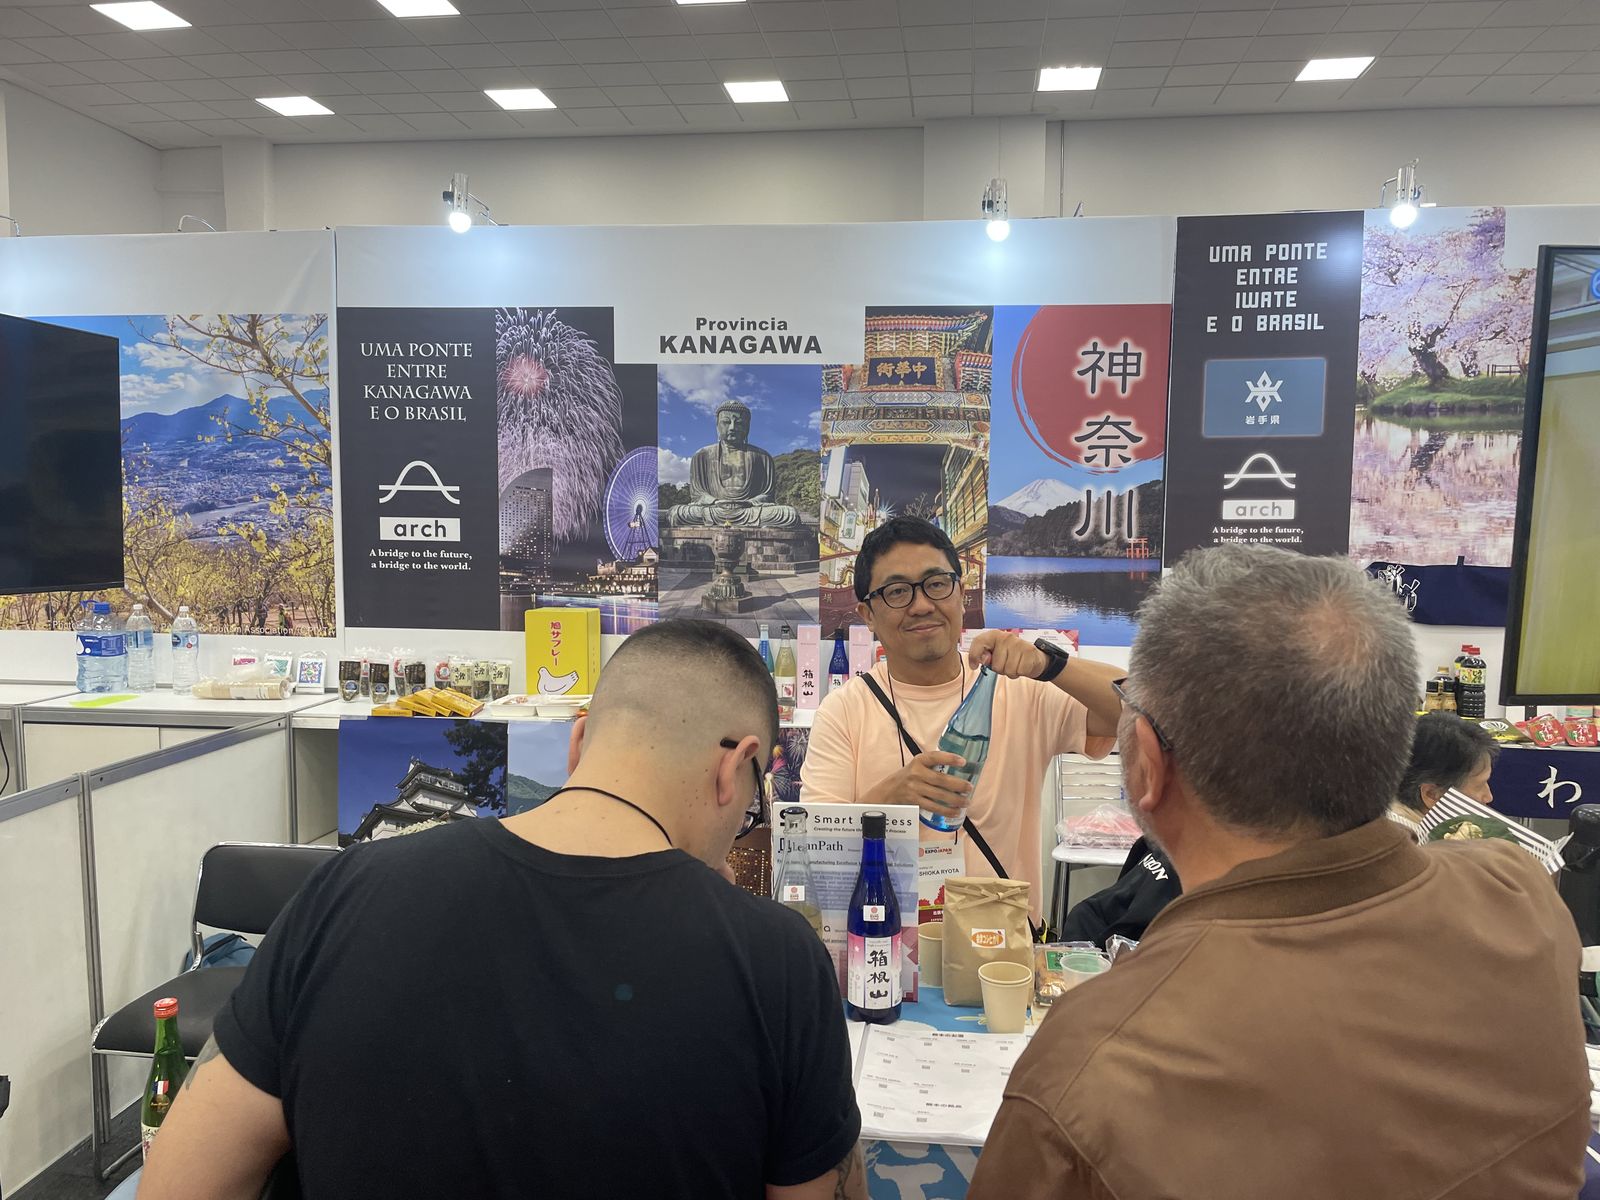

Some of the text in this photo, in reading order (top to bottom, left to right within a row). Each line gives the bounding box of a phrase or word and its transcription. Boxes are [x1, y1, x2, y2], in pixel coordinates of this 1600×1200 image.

[1209, 242, 1328, 263] UMA PONTE
[1236, 267, 1298, 286] ENTRE
[1235, 290, 1297, 309] IWATE
[696, 317, 788, 331] Provincia
[1206, 313, 1325, 333] E O BRASIL
[360, 342, 473, 358] UMA PONTE
[659, 335, 822, 354] KANAGAWA
[386, 363, 447, 379] ENTRE
[363, 384, 473, 400] KANAGAWA
[370, 405, 467, 422] E O BRASIL
[1244, 415, 1280, 425] 岩手県
[1074, 341, 1143, 539] 神奈川
[1235, 501, 1282, 517] arch
[393, 520, 447, 538] arch
[1212, 526, 1219, 534] A
[1220, 526, 1248, 535] bridge
[1259, 526, 1274, 534] the
[1275, 526, 1304, 535] future,
[1220, 536, 1248, 544] bridge
[369, 548, 473, 560] A bridge to the future,
[379, 560, 410, 571] bridge
[412, 562, 422, 570] to
[423, 561, 439, 570] the
[440, 562, 472, 571] world.
[1537, 765, 1582, 809] わ
[814, 814, 853, 825] Smart
[867, 949, 890, 999] 箱根山
